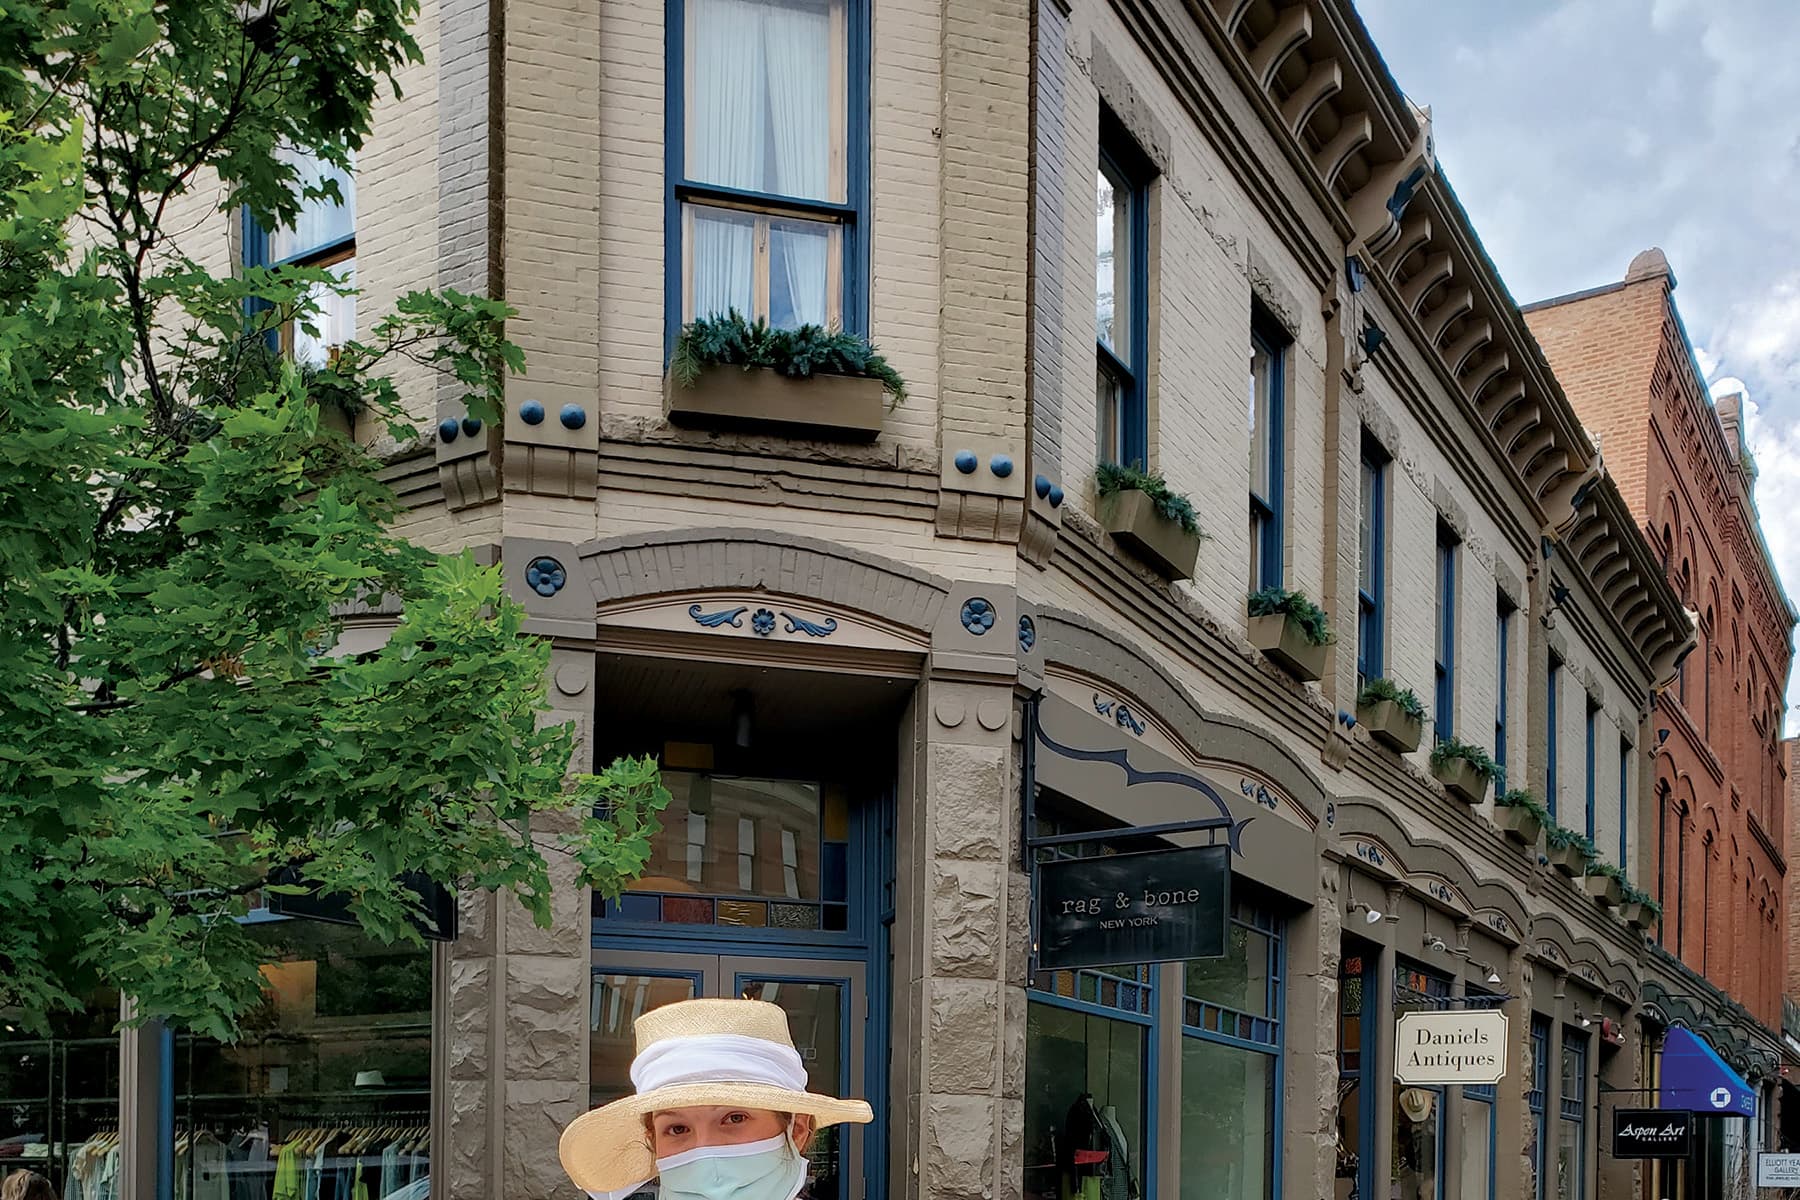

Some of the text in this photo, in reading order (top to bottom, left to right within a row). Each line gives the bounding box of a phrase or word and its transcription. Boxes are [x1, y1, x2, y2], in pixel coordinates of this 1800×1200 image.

[1062, 887, 1200, 915] rag & bone
[1100, 916, 1158, 929] NEW YORK
[1416, 1027, 1489, 1046] Daniels
[1407, 1050, 1496, 1071] Antiques
[1618, 1122, 1685, 1140] Aspen Art
